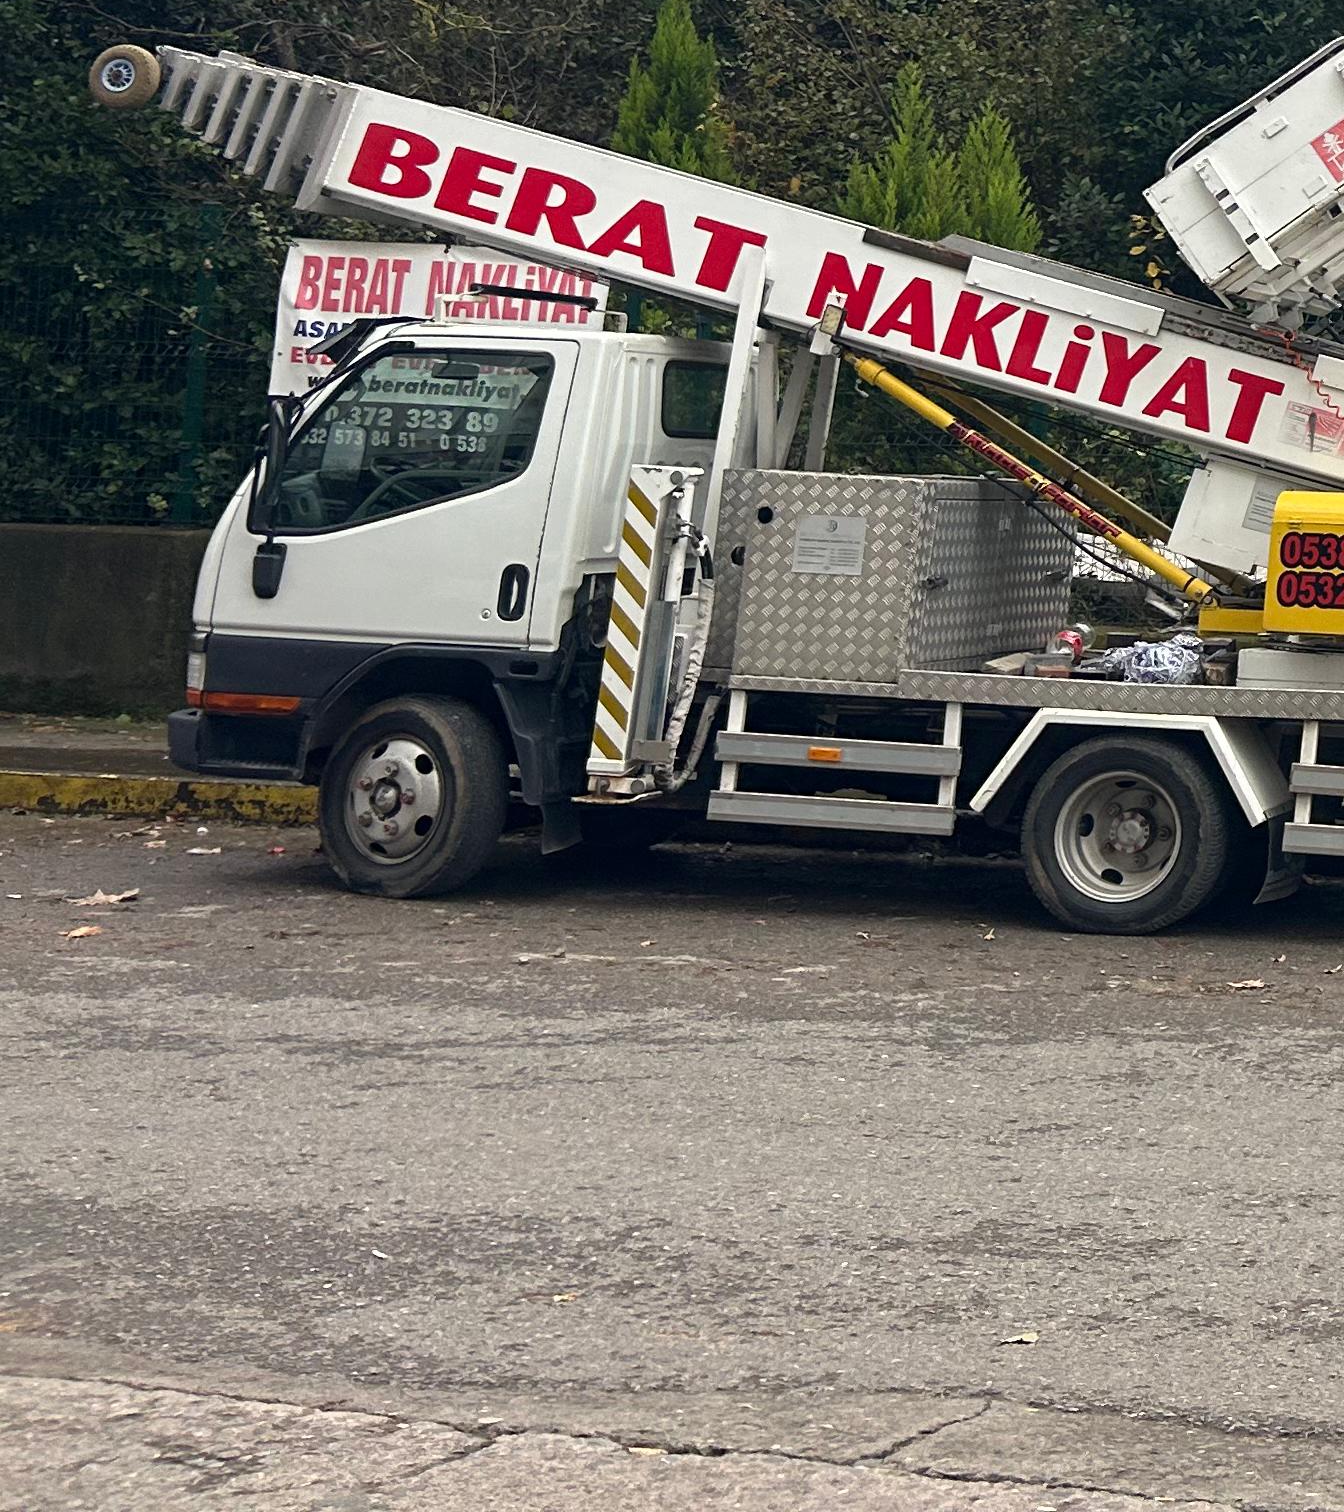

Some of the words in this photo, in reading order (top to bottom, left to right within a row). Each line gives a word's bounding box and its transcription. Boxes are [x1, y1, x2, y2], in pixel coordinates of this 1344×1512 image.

[348, 123, 767, 292] BERAT
[295, 255, 412, 315] BERAT
[334, 428, 364, 446] 573
[371, 430, 391, 447] 84
[398, 431, 416, 449] 51
[439, 433, 450, 451] 0
[405, 407, 453, 431] 323
[466, 411, 499, 433] 89
